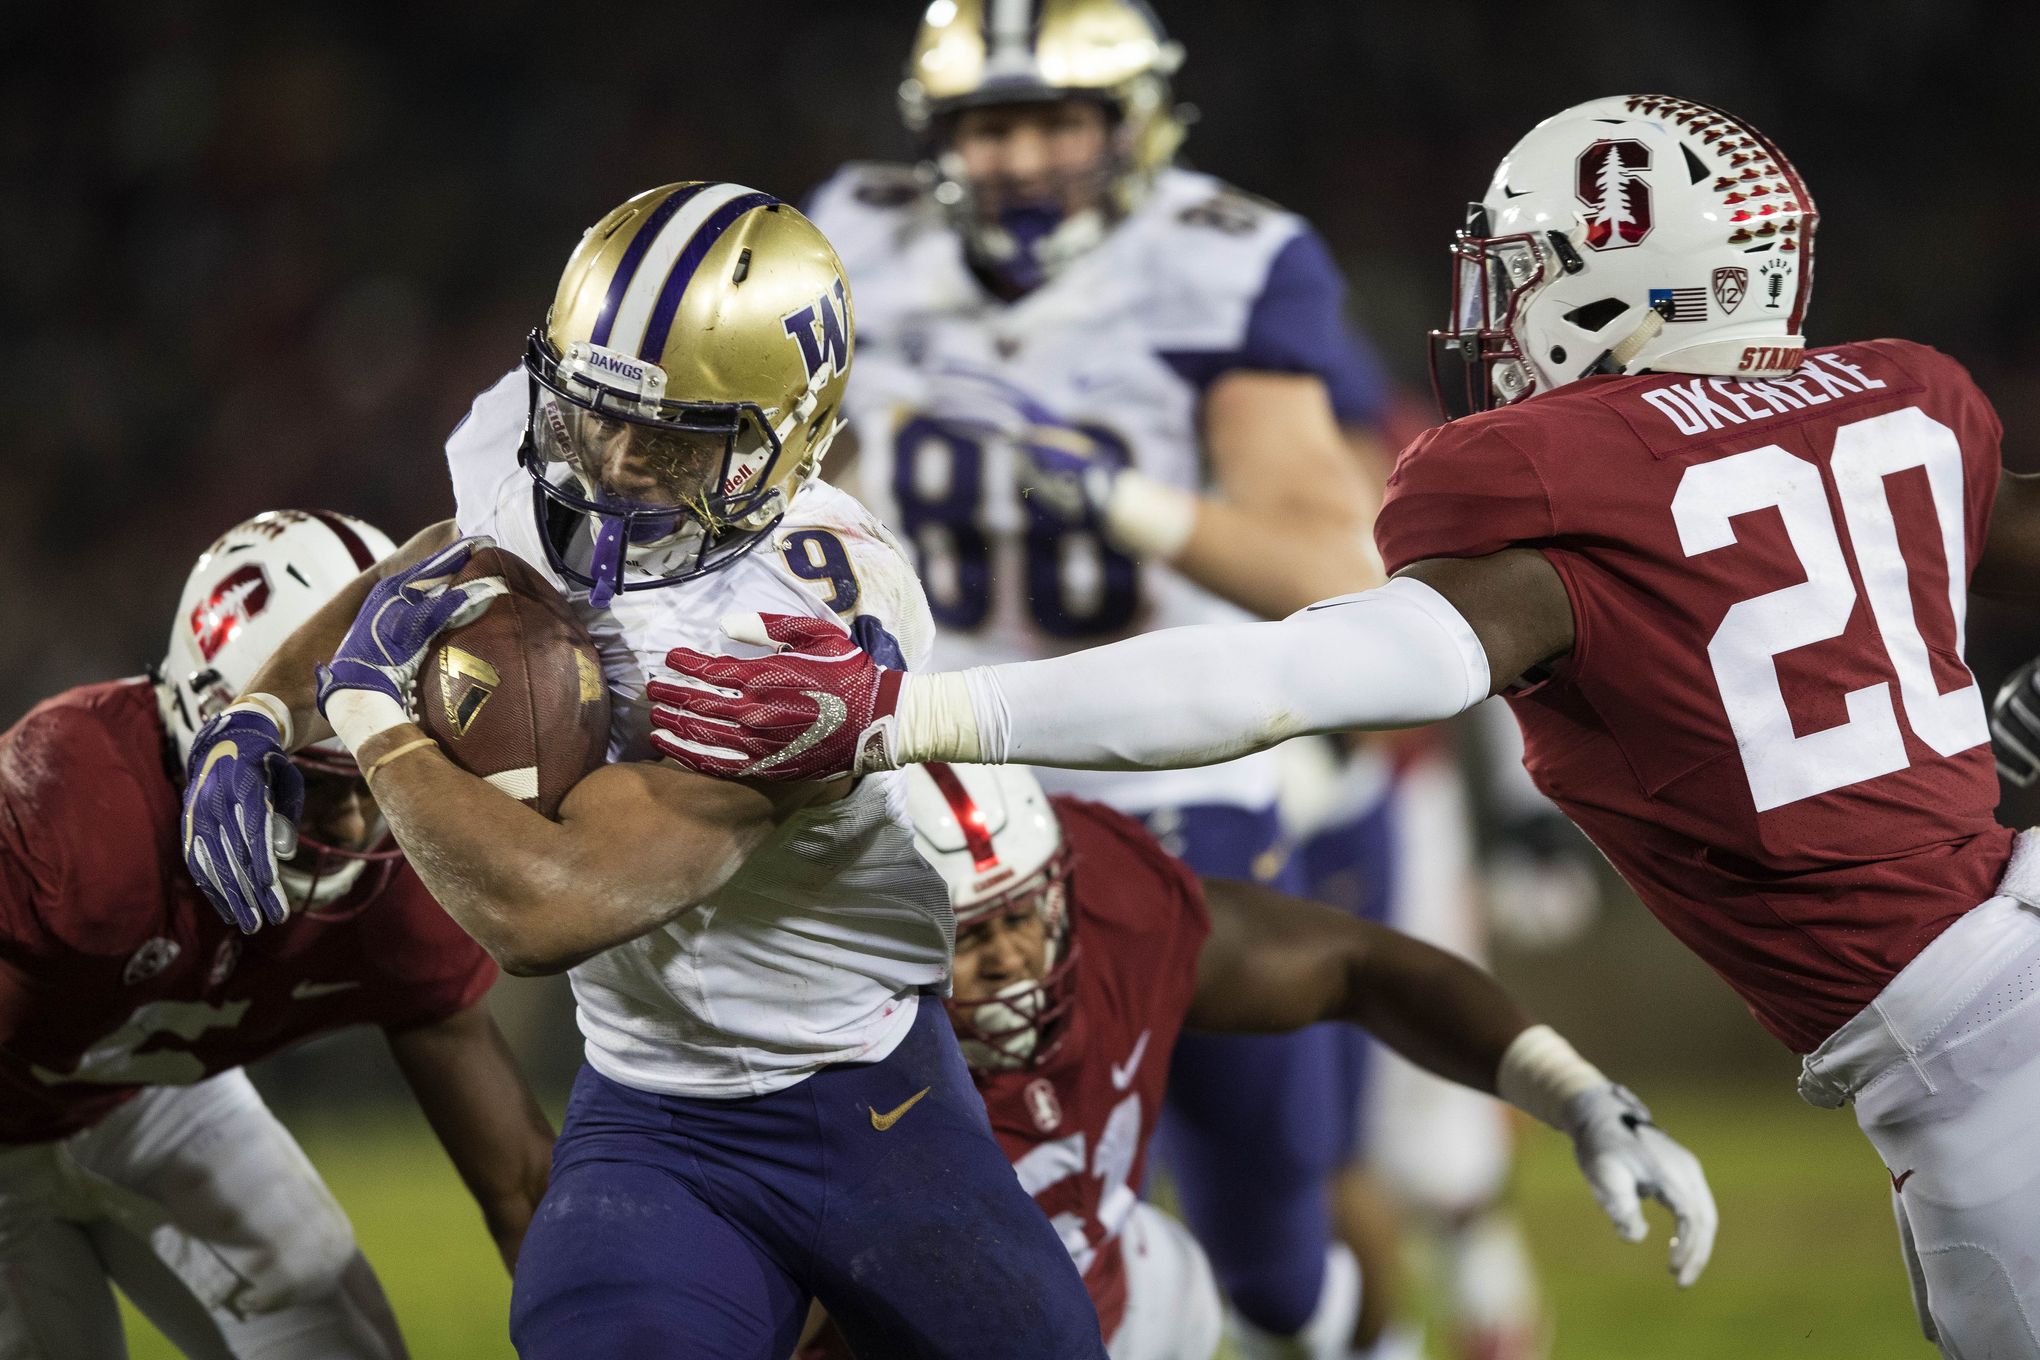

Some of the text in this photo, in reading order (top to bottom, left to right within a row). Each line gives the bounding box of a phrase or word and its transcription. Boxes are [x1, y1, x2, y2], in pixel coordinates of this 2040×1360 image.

[1714, 267, 1748, 295] PAC
[1720, 288, 1739, 304] 12
[780, 276, 849, 386] W
[1738, 347, 1805, 372] STAN
[590, 351, 643, 381] DAWGS
[1640, 353, 1888, 436] OKEREKE
[723, 464, 754, 497] dell
[894, 414, 1138, 640] 88
[780, 526, 862, 618] 9
[1670, 405, 1992, 813] 20
